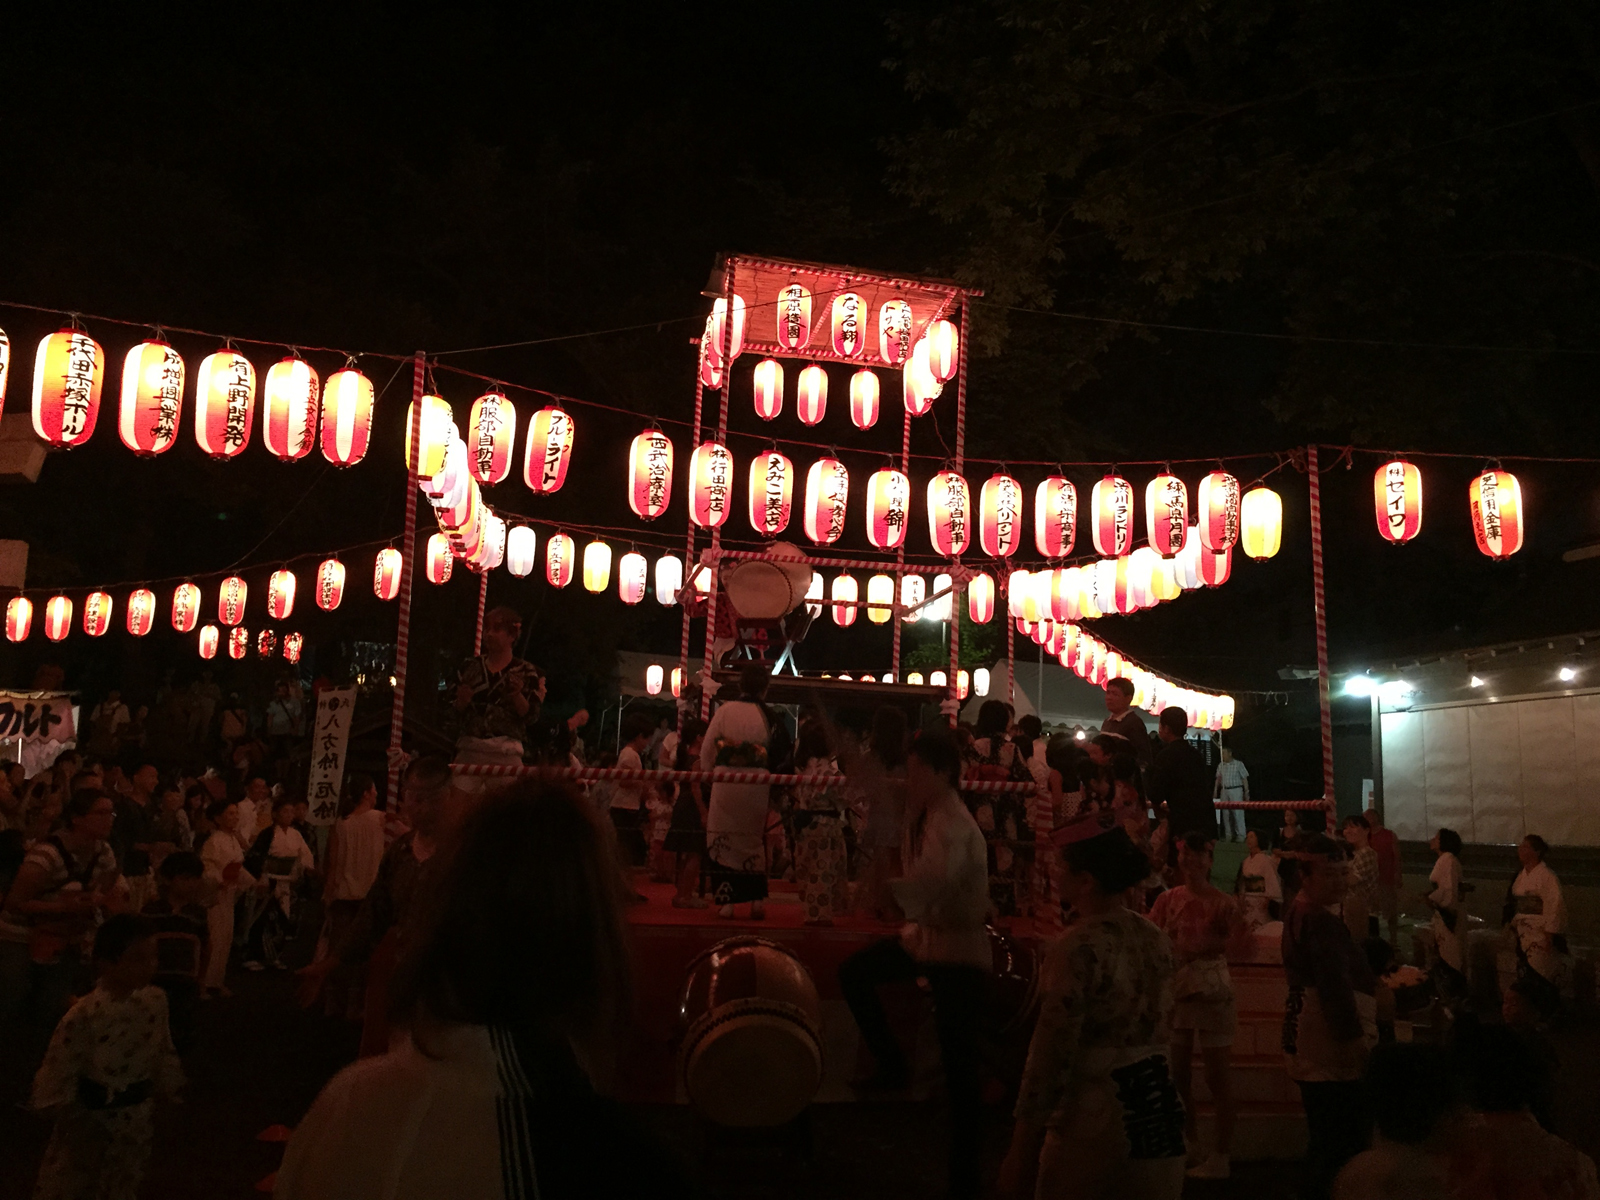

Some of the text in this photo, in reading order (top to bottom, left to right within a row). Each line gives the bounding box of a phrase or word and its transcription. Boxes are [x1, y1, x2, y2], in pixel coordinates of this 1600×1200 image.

[838, 296, 860, 343] なる翔
[61, 337, 97, 435] 千代田赤塚ホール
[542, 415, 565, 484] ブルーライト
[643, 437, 669, 508] 西武治療室
[882, 474, 905, 533] 小理錦
[1114, 480, 1131, 550] 渋川ランドリー
[1162, 480, 1186, 548] 練馬皐月園
[1481, 474, 1504, 541] 芝信用金庫
